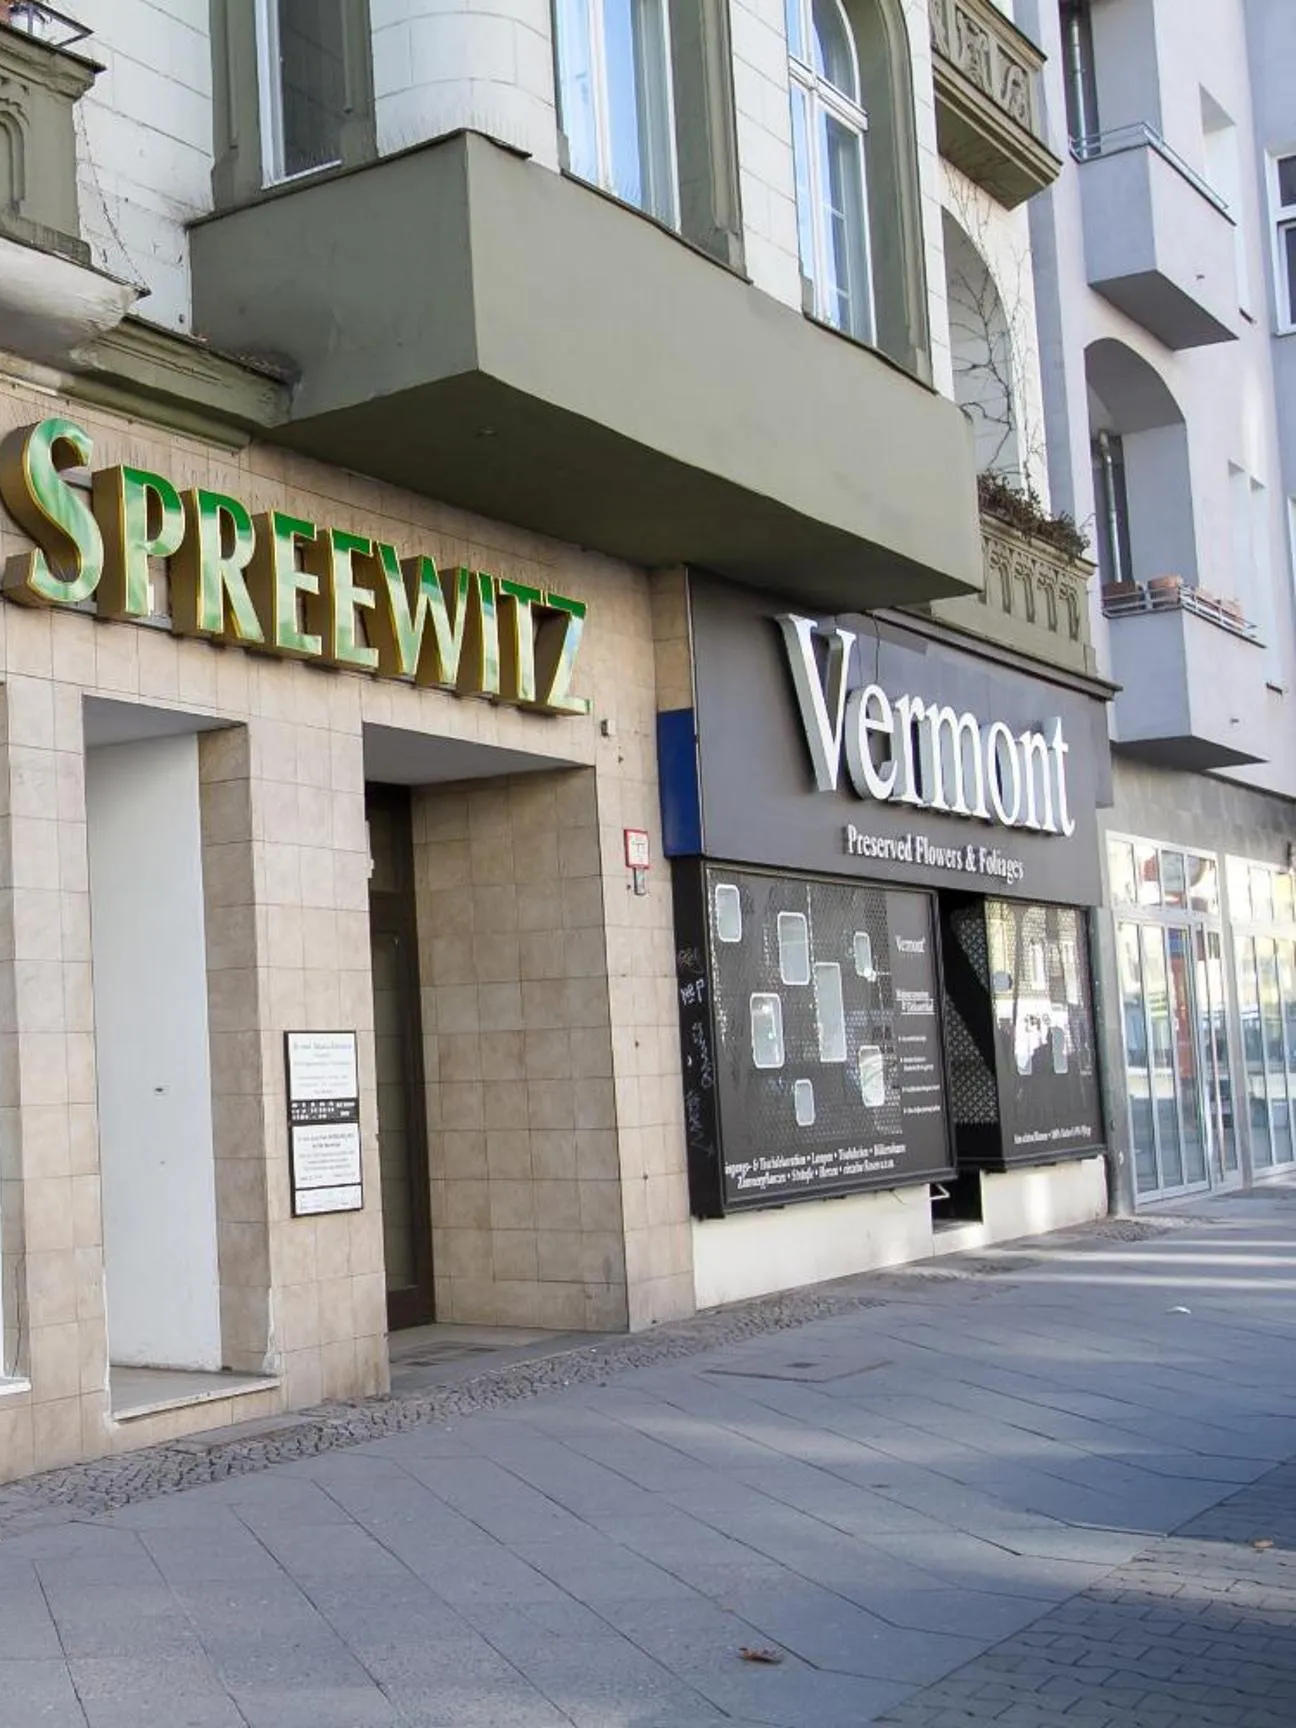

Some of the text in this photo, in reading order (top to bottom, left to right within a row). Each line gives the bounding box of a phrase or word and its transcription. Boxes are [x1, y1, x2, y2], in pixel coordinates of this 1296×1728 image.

[774, 613, 1075, 838] Vermont
[847, 824, 1024, 884] Preserved Flowers & Foliages
